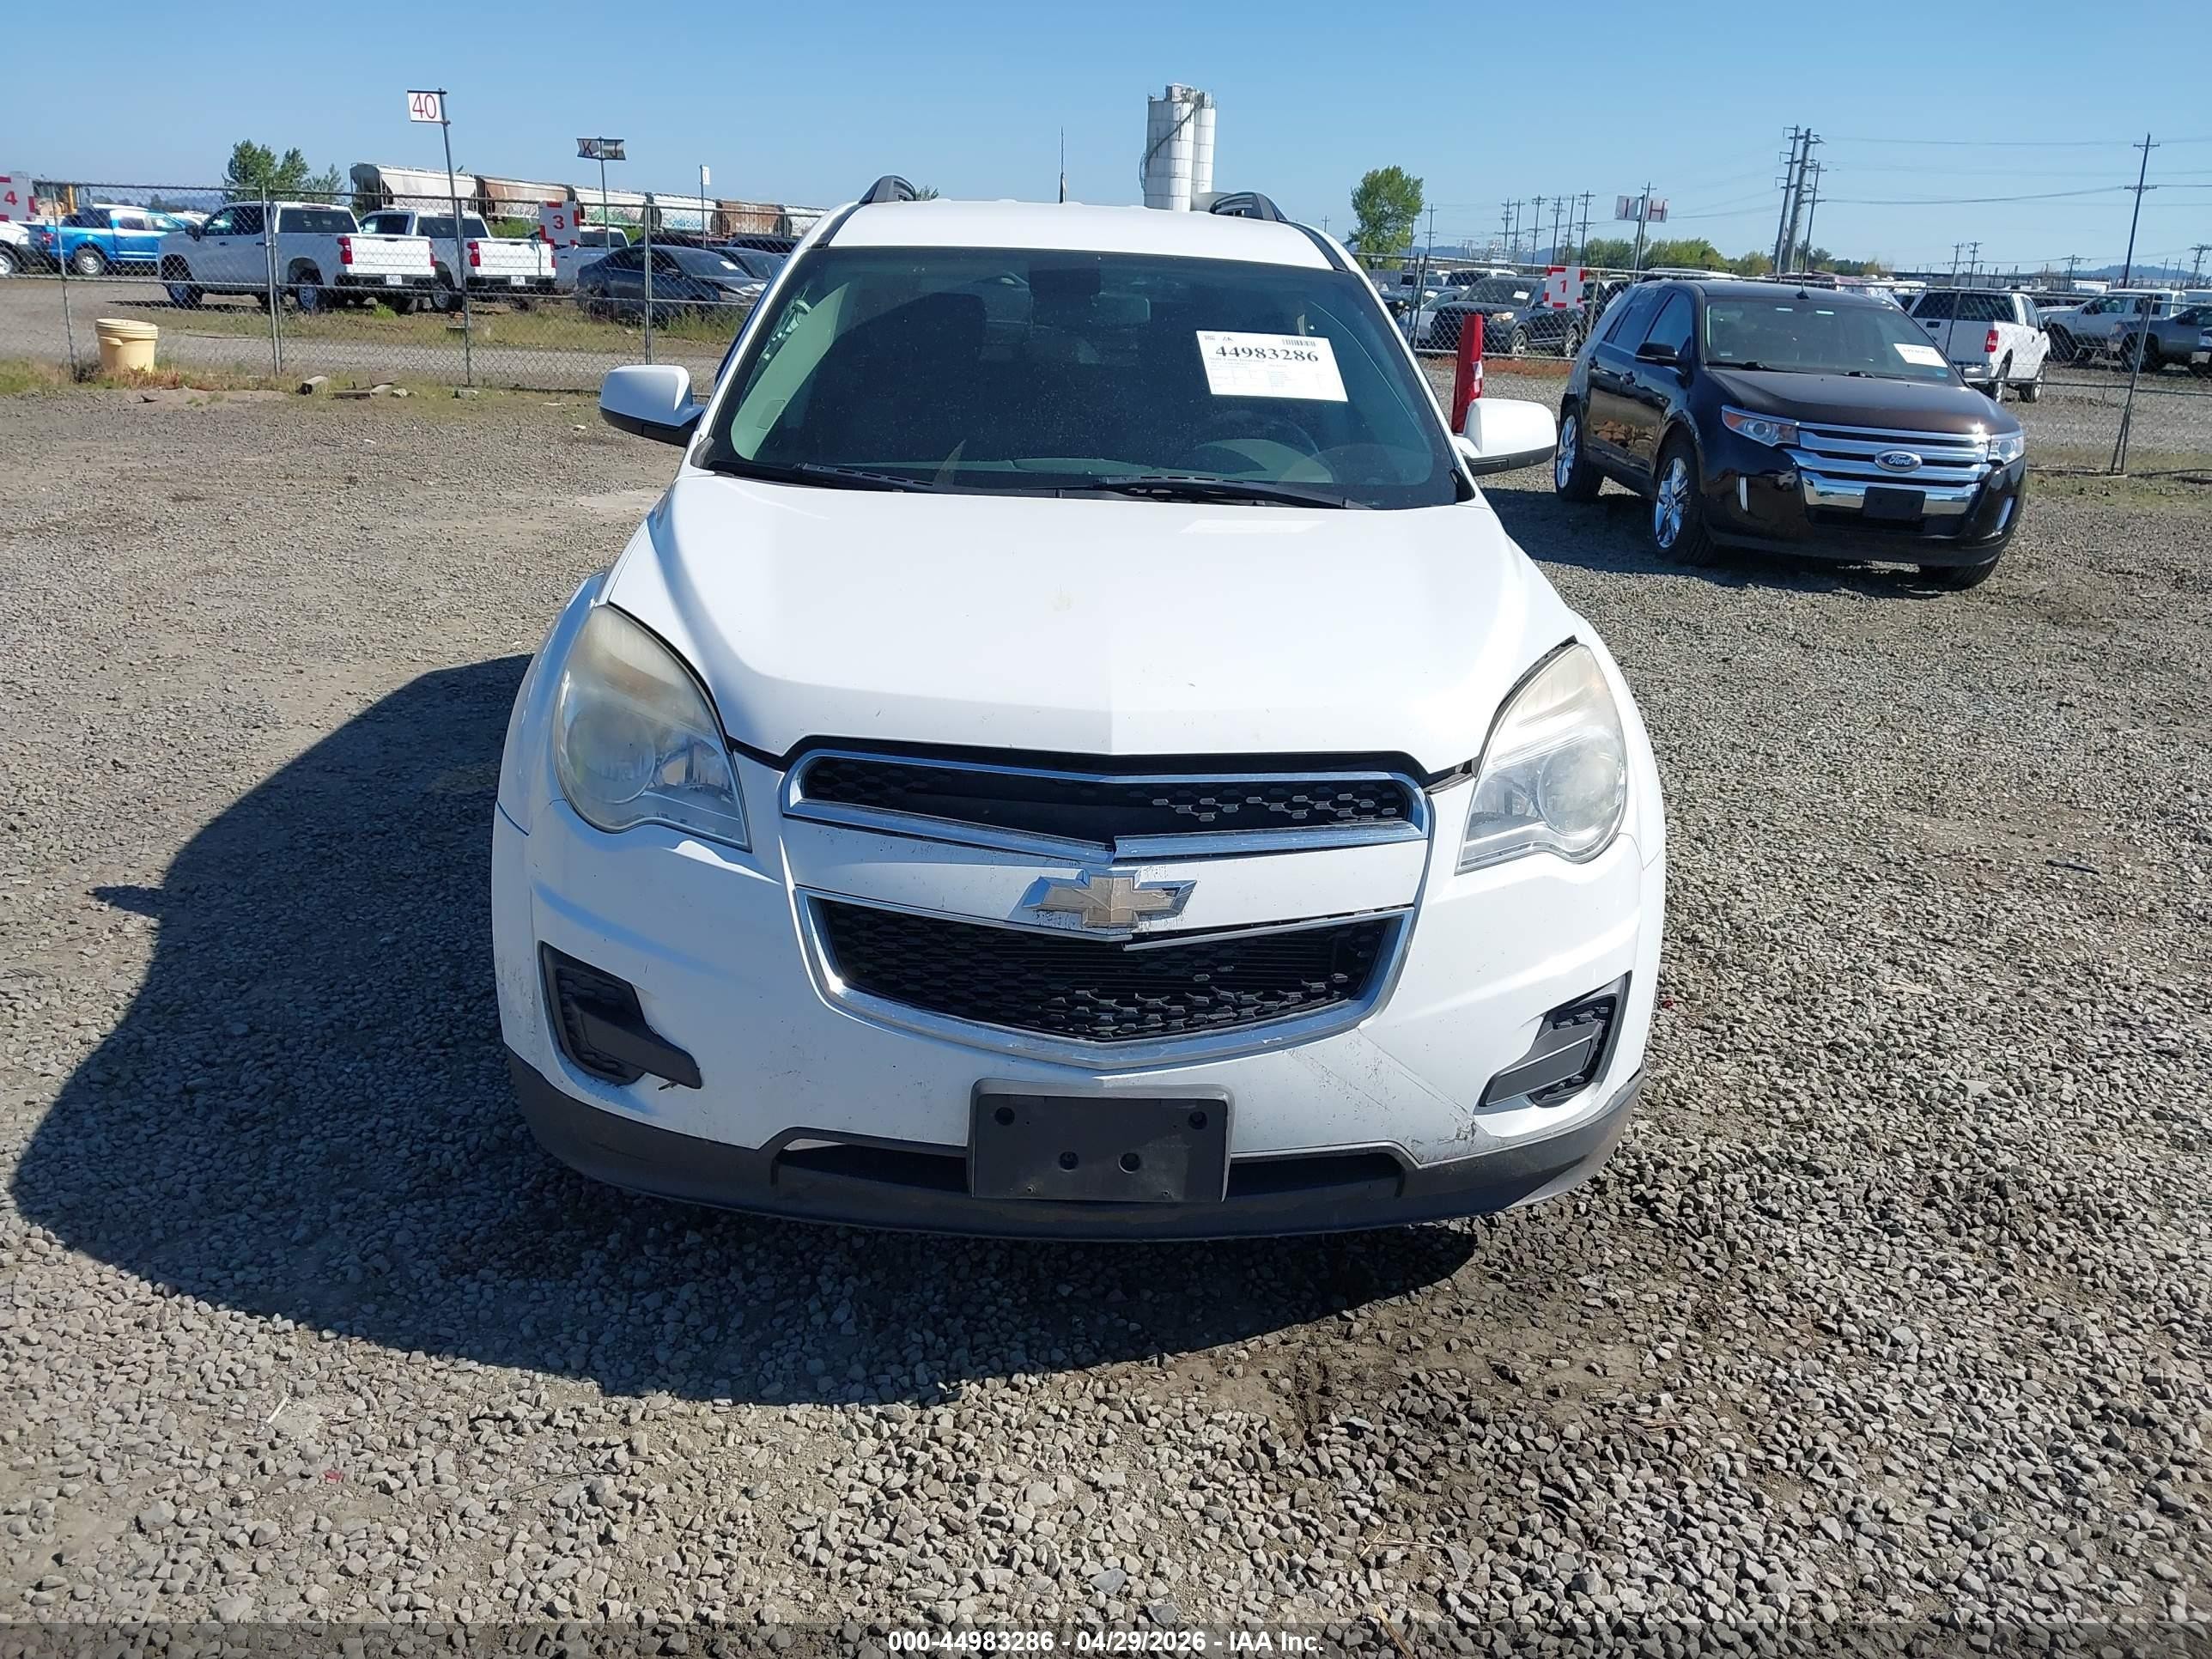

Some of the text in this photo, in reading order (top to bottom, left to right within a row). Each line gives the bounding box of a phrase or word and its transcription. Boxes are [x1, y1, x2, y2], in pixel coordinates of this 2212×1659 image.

[412, 94, 436, 119] 40
[4, 191, 18, 205] 4
[1648, 200, 1665, 221] H
[553, 215, 564, 229] 3
[1560, 280, 1567, 293] 1
[1216, 345, 1319, 362] 44983286
[1888, 453, 1911, 465] Ford
